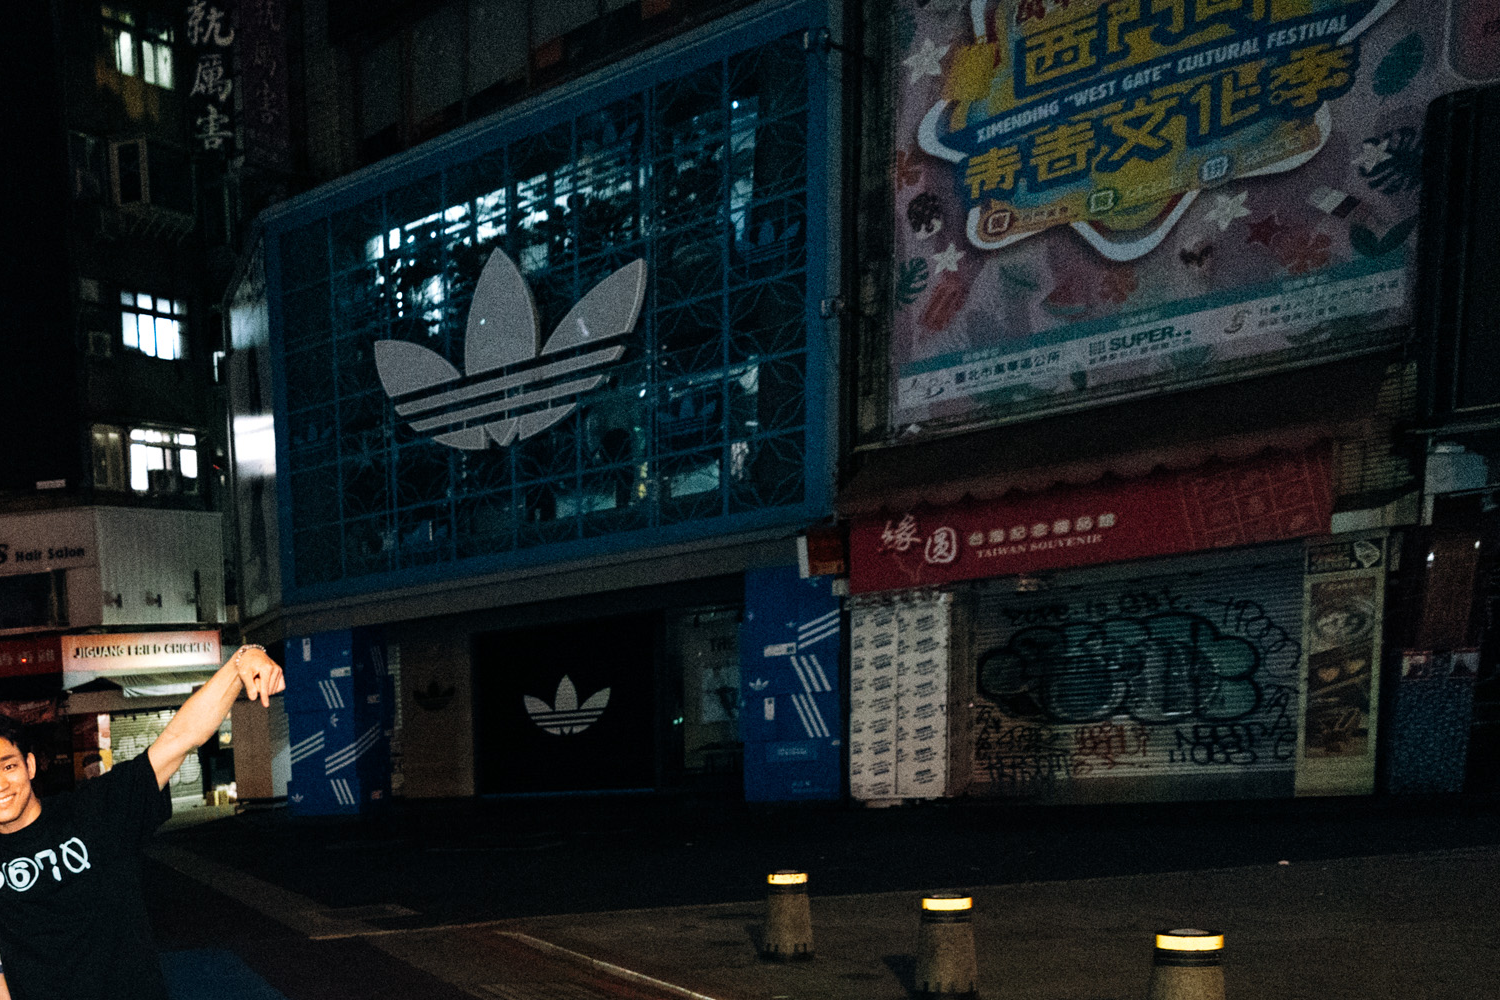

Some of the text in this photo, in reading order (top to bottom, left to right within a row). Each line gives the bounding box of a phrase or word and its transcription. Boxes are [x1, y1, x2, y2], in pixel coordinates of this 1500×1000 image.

[976, 99, 1060, 143] XIMENDING
[1176, 37, 1261, 74] CULTURAL
[1266, 14, 1349, 49] FESTIVAL
[15, 549, 42, 562] Hair
[48, 545, 85, 560] Salon
[976, 544, 1027, 559] TAIWAN
